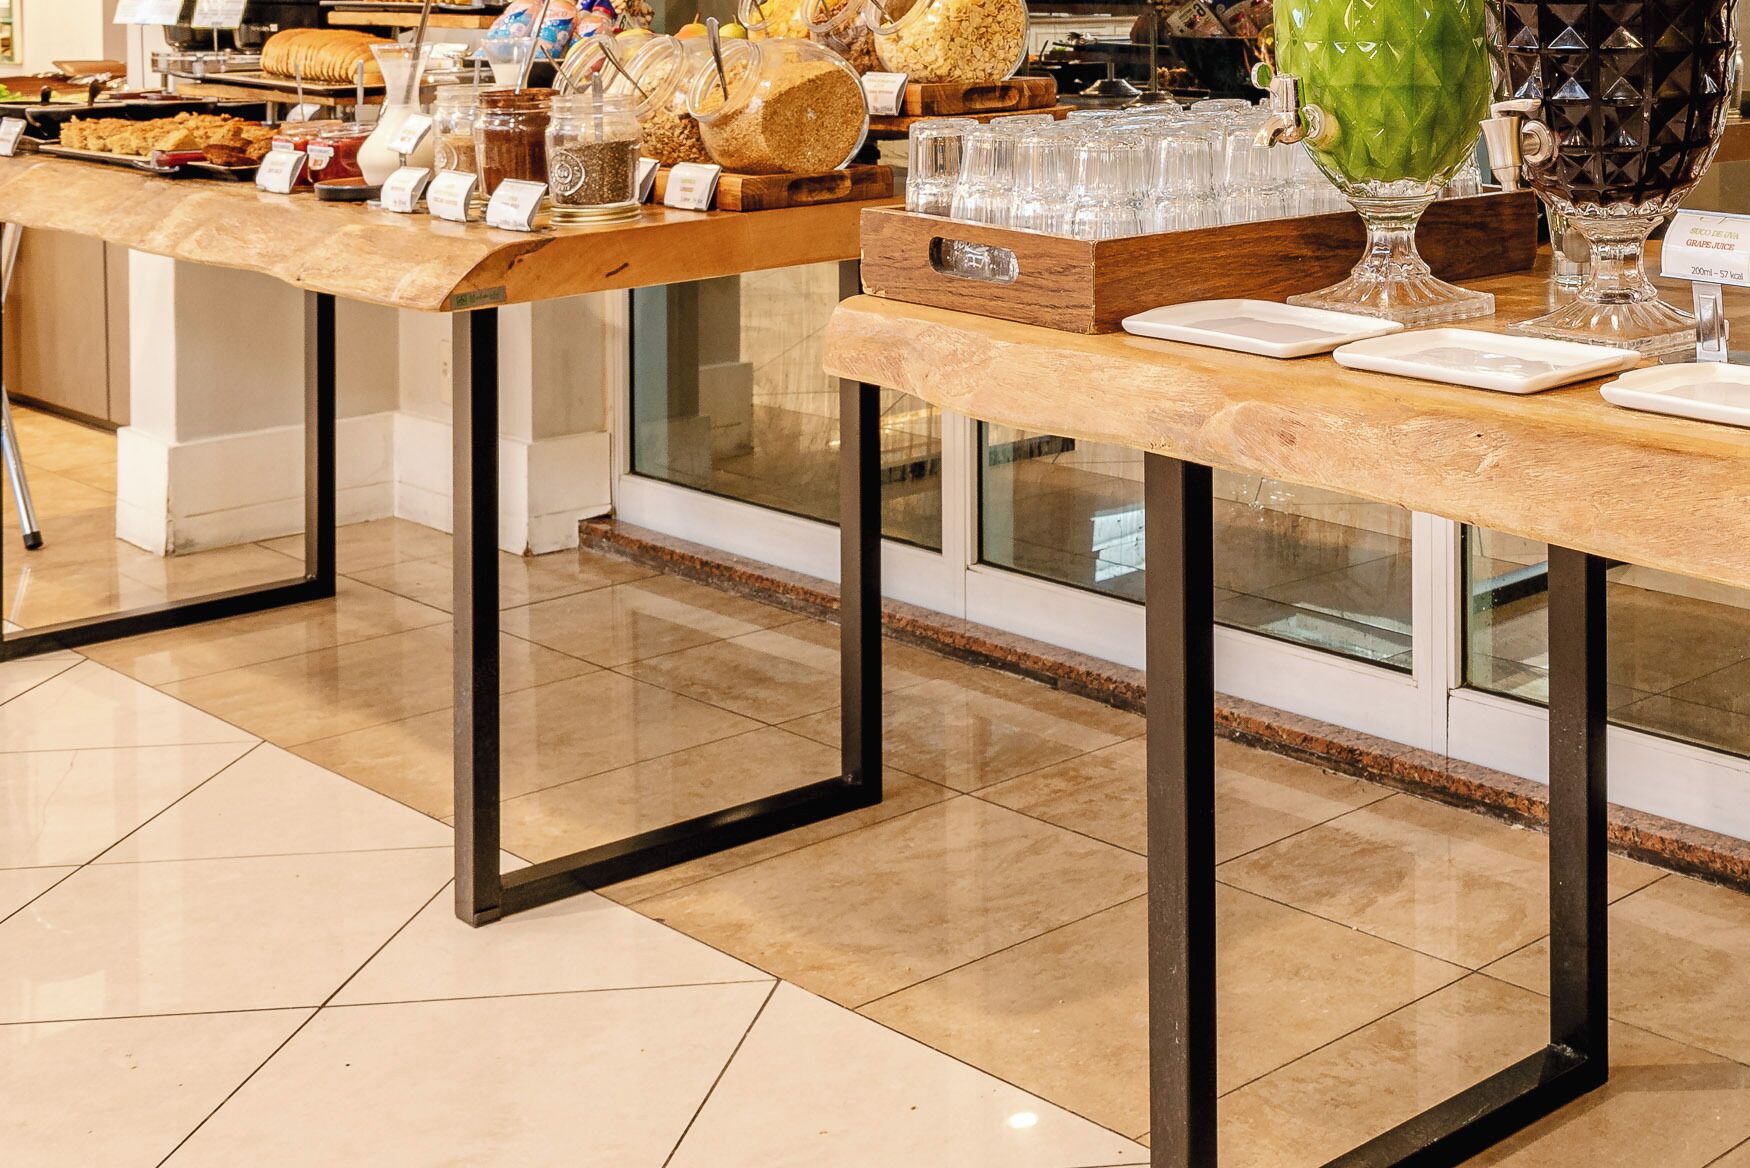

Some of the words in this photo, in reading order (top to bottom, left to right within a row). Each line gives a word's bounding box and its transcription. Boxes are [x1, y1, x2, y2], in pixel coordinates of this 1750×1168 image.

[1686, 239, 1711, 249] GRAPE
[1712, 242, 1735, 250] JUICE
[1691, 267, 1712, 276] 200ml
[1719, 270, 1729, 278] 57
